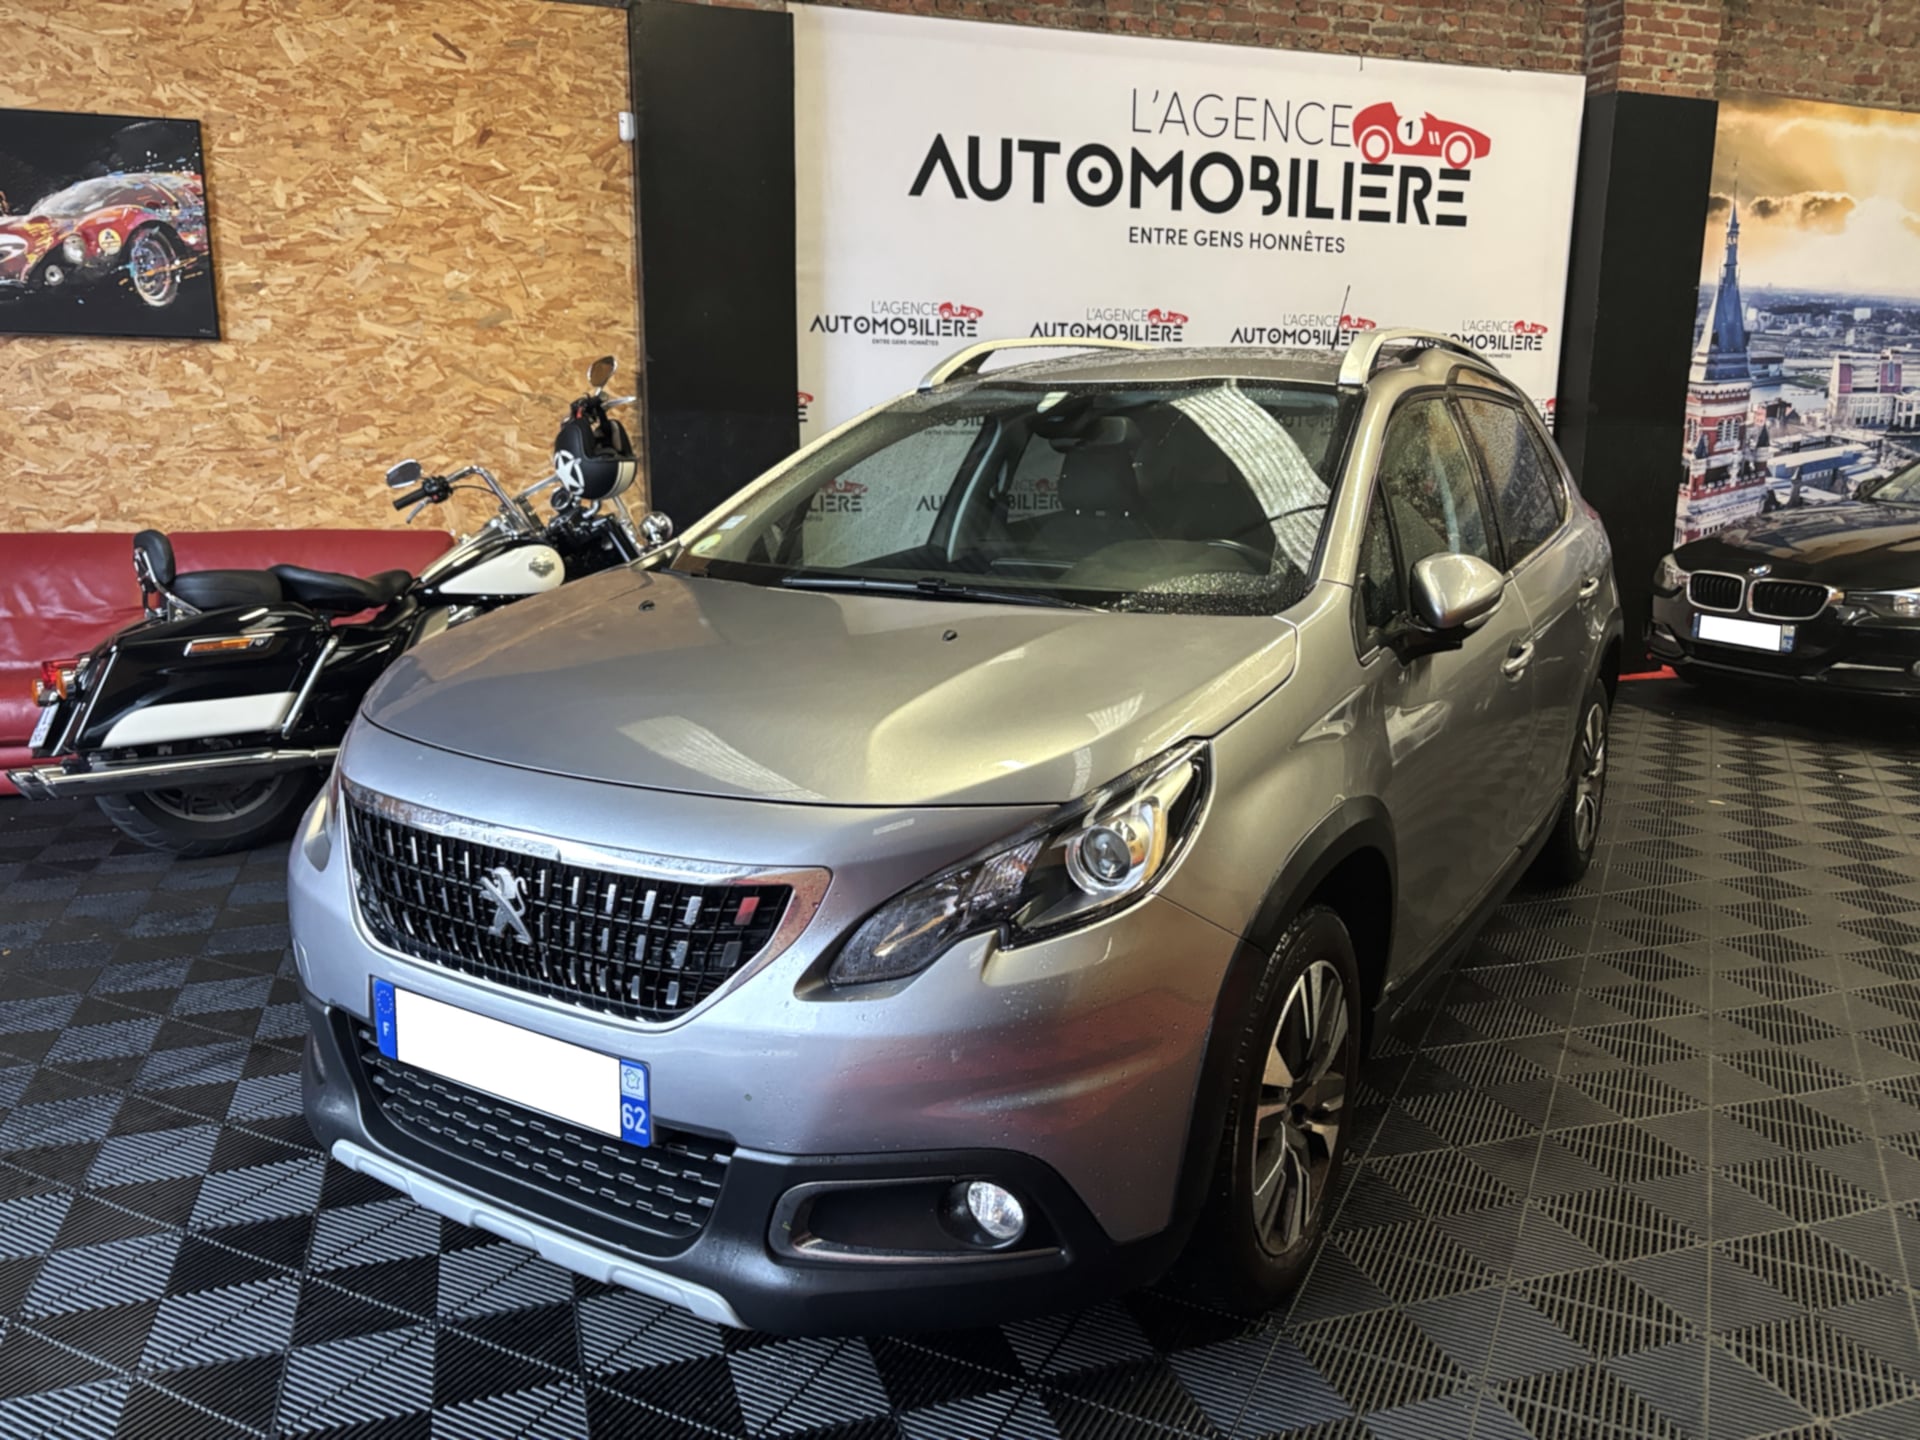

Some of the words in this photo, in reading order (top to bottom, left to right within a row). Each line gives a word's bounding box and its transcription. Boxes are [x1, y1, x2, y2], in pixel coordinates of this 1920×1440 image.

[1132, 87, 1352, 148] L'AGENCE
[1128, 226, 1188, 246] ENTRE
[1193, 229, 1244, 249] GENS
[1249, 231, 1346, 254] HONNÊTES
[871, 301, 938, 316] L'AGENCE
[1086, 308, 1147, 322] L'AGENCE
[1283, 314, 1338, 328] L'AGENCE
[1462, 320, 1514, 333] L'AGENCE
[383, 1021, 390, 1037] F
[622, 1102, 647, 1135] 62
